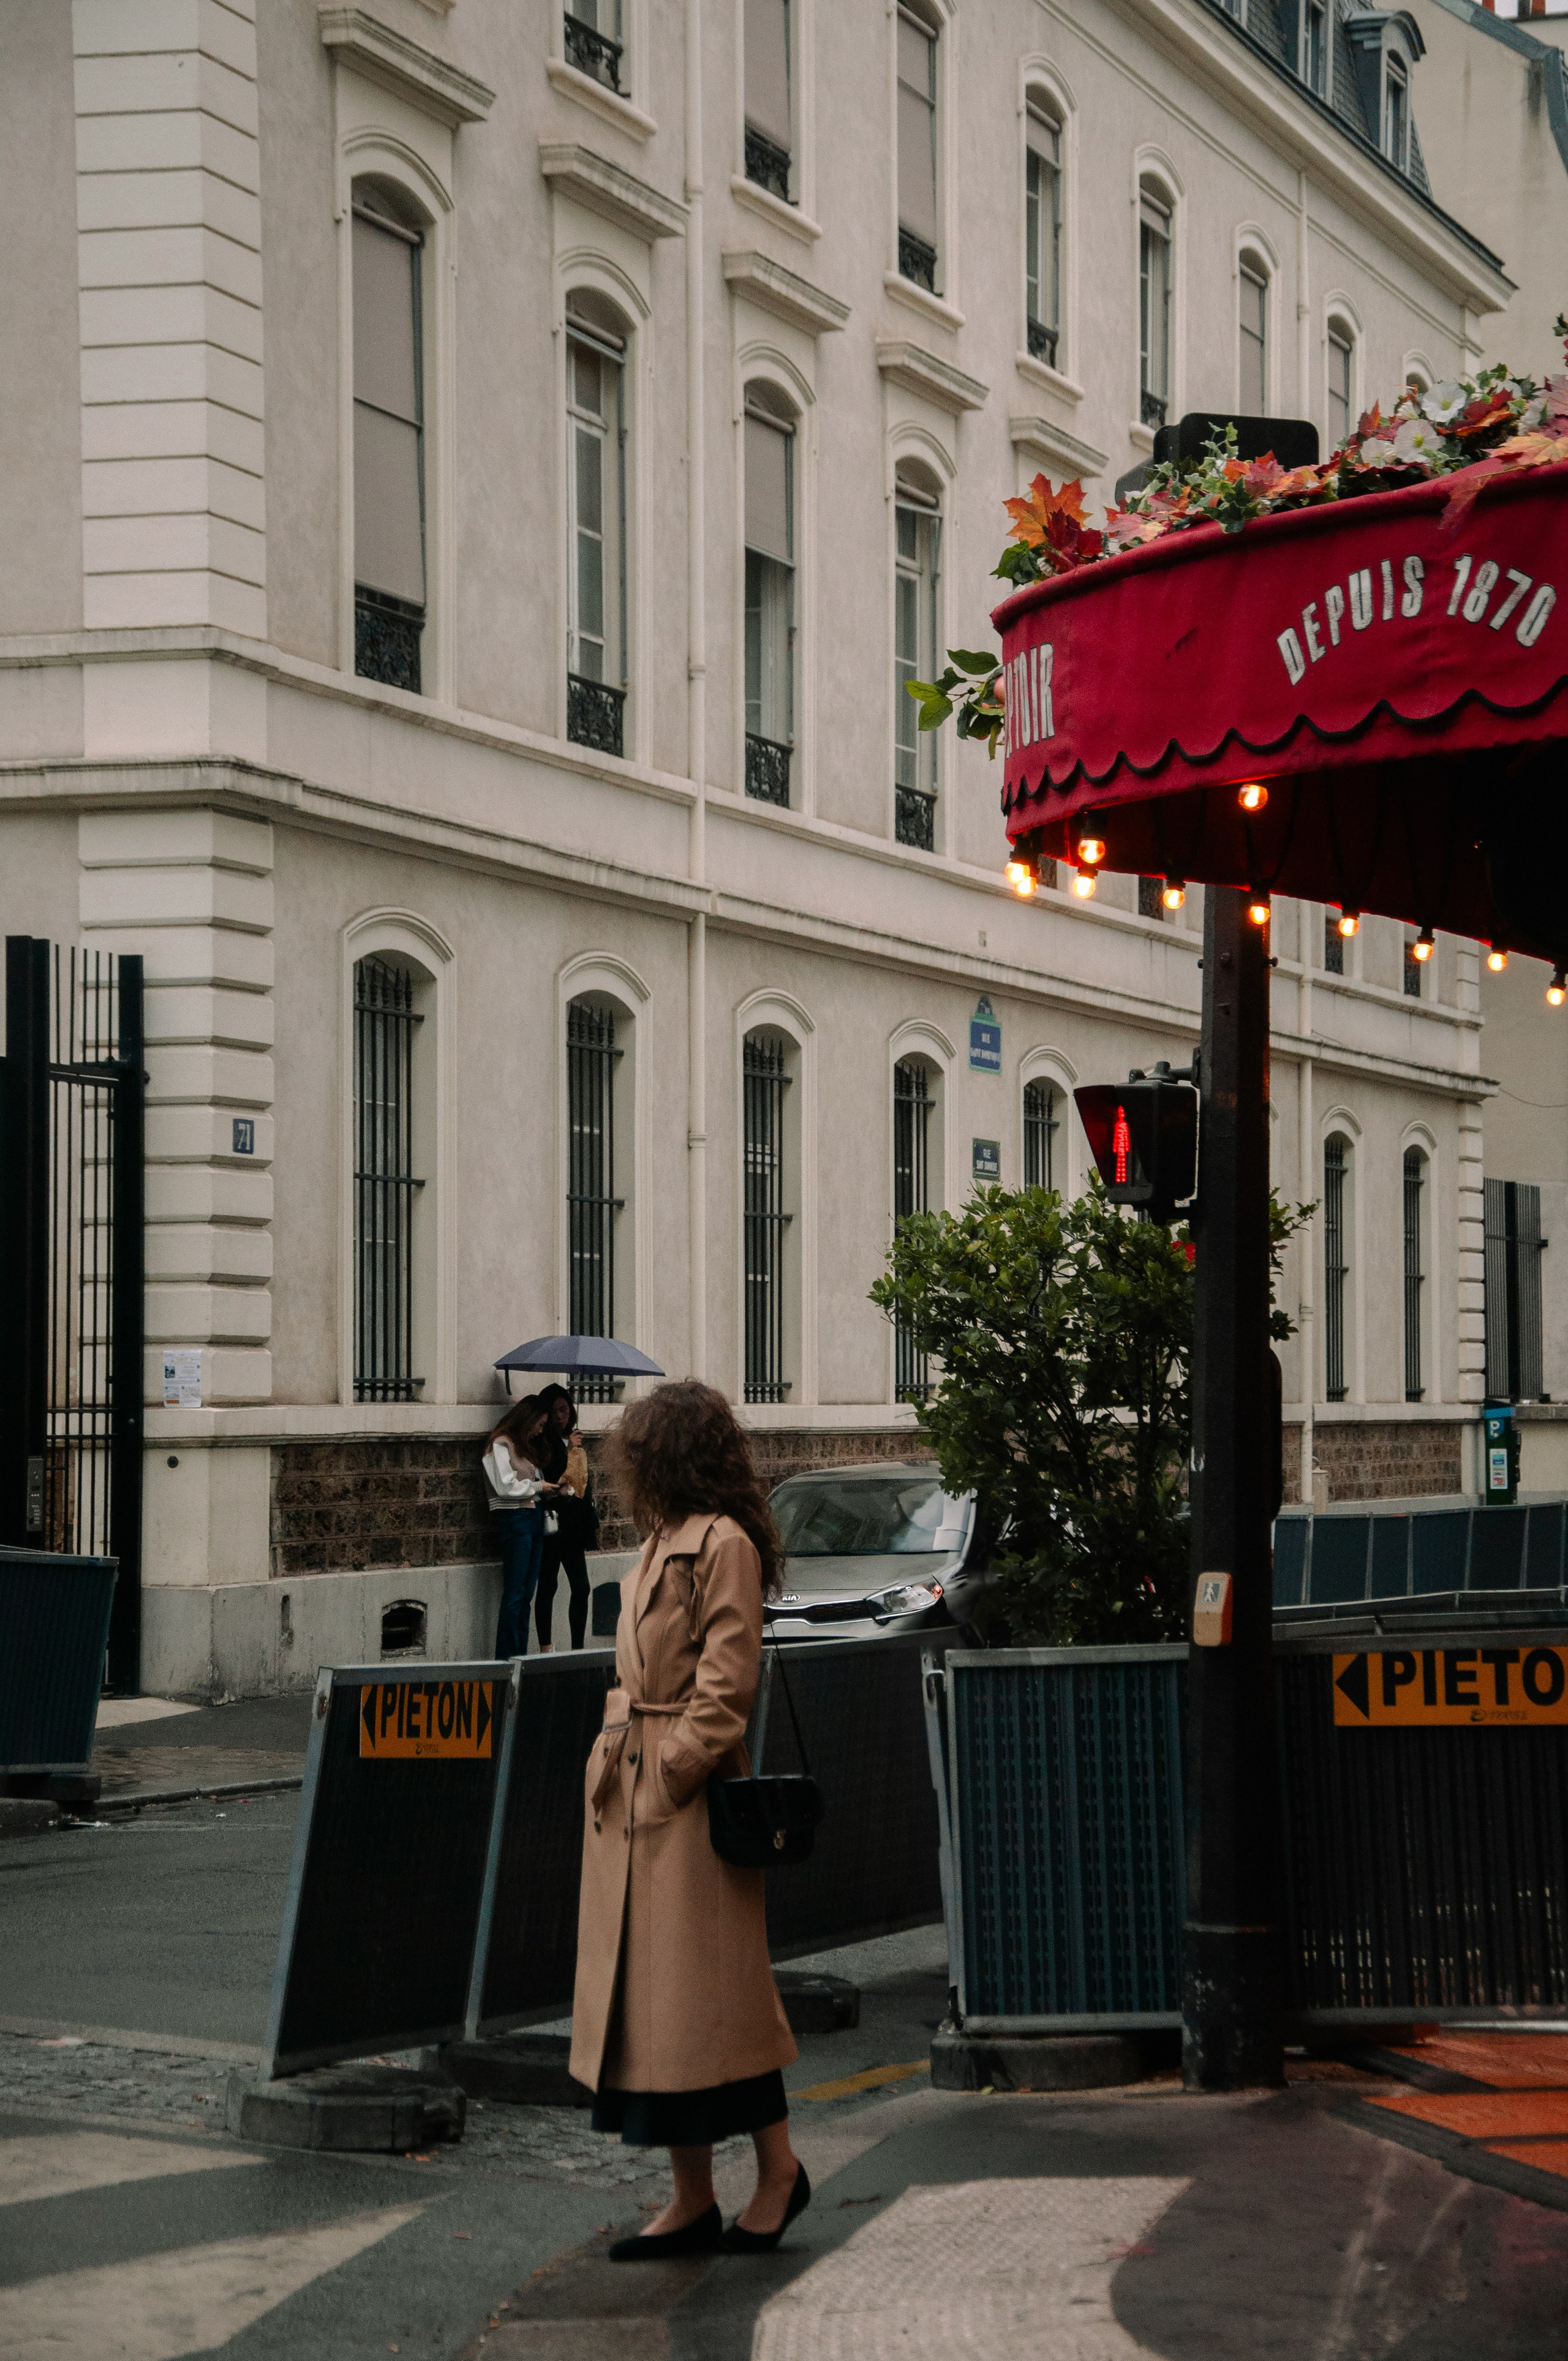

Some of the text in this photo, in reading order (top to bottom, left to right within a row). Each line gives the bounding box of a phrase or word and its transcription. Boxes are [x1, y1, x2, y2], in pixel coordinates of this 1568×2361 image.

[1276, 553, 1558, 687] DEPUIS 1870
[238, 1123, 251, 1150] 71
[1382, 1648, 1565, 1706] PIETO
[381, 1682, 473, 1739] PIETON
